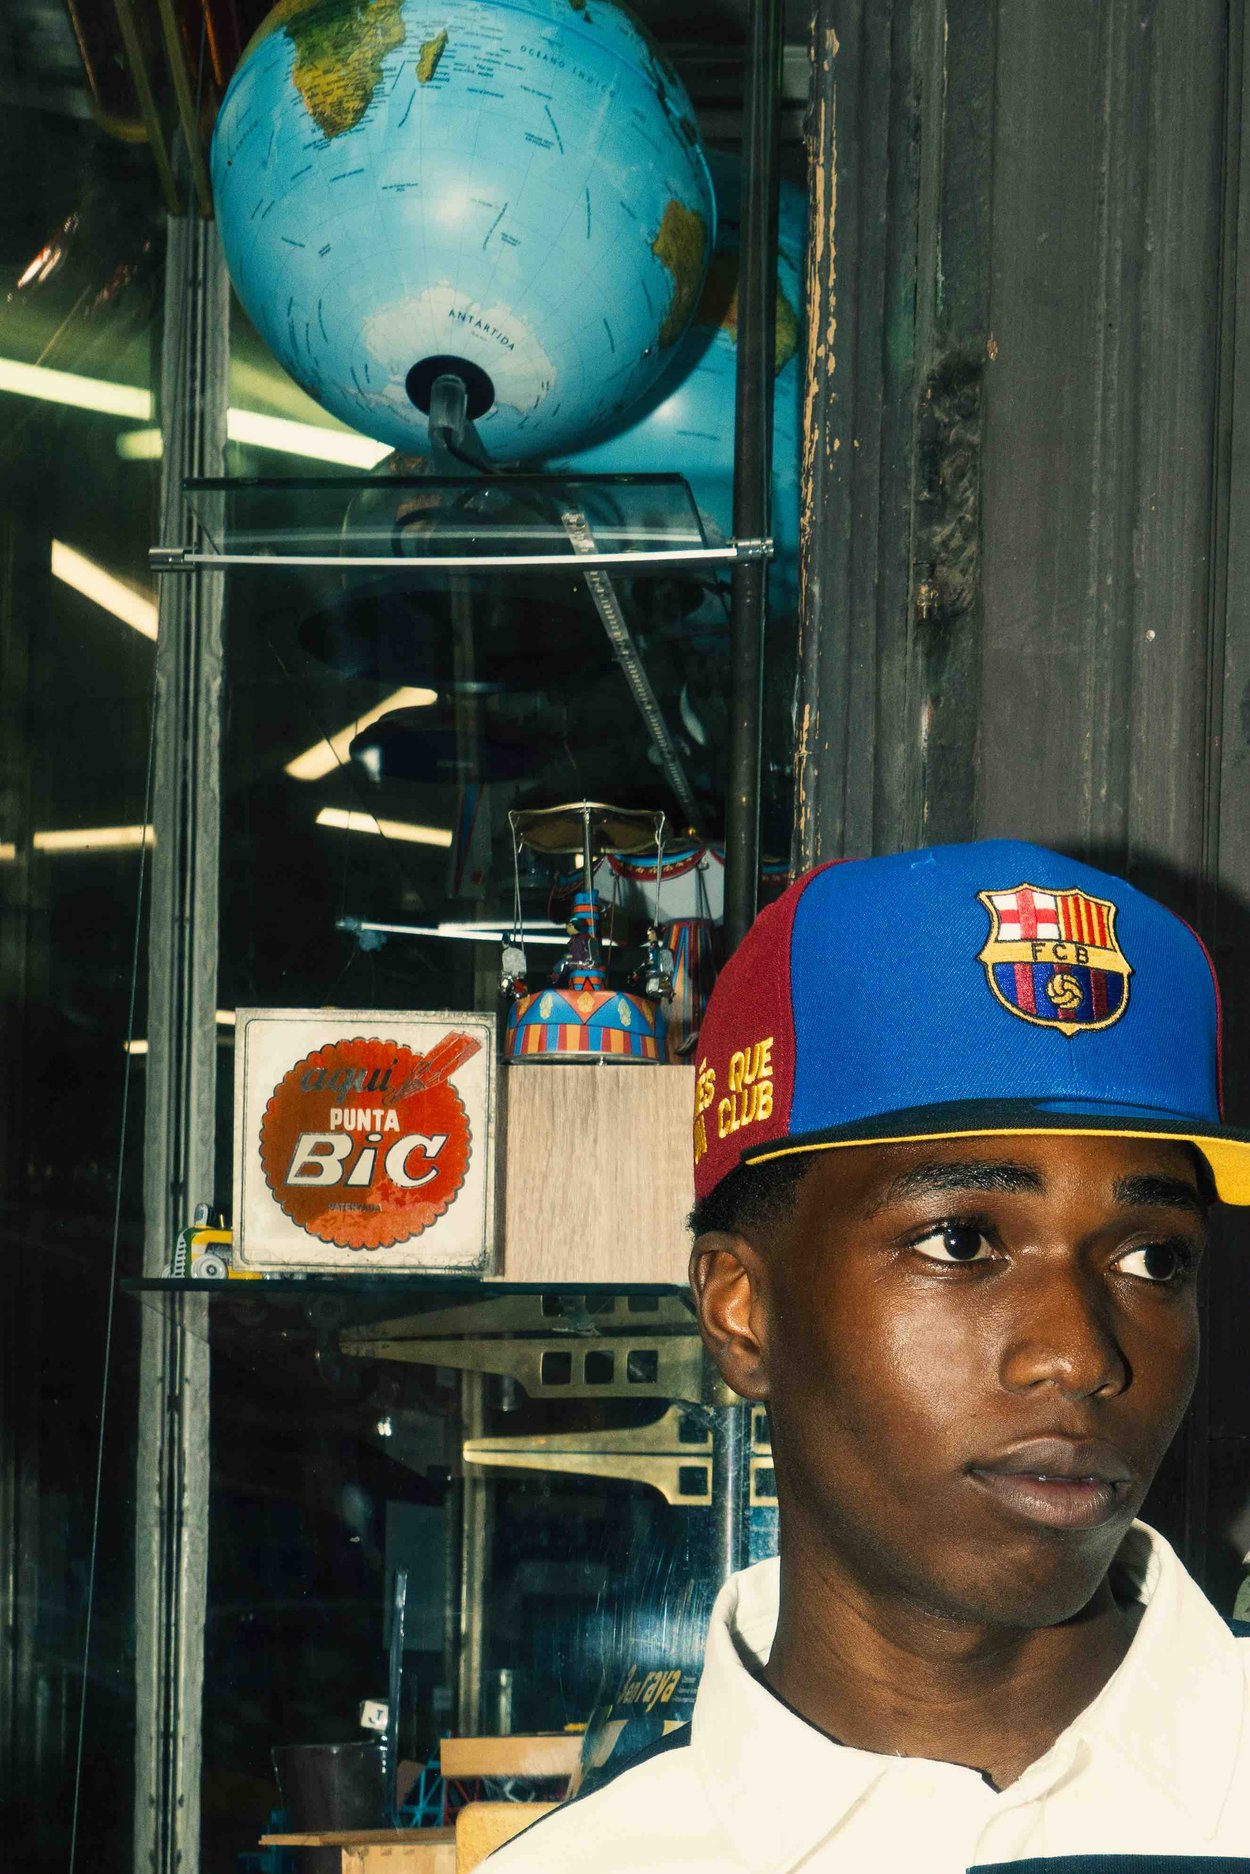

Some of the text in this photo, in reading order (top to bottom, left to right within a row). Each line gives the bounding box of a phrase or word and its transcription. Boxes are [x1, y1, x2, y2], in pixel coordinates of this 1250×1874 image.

[728, 1036, 774, 1093] QUE
[329, 1107, 401, 1132] PUNTA
[718, 1080, 774, 1139] CLUB
